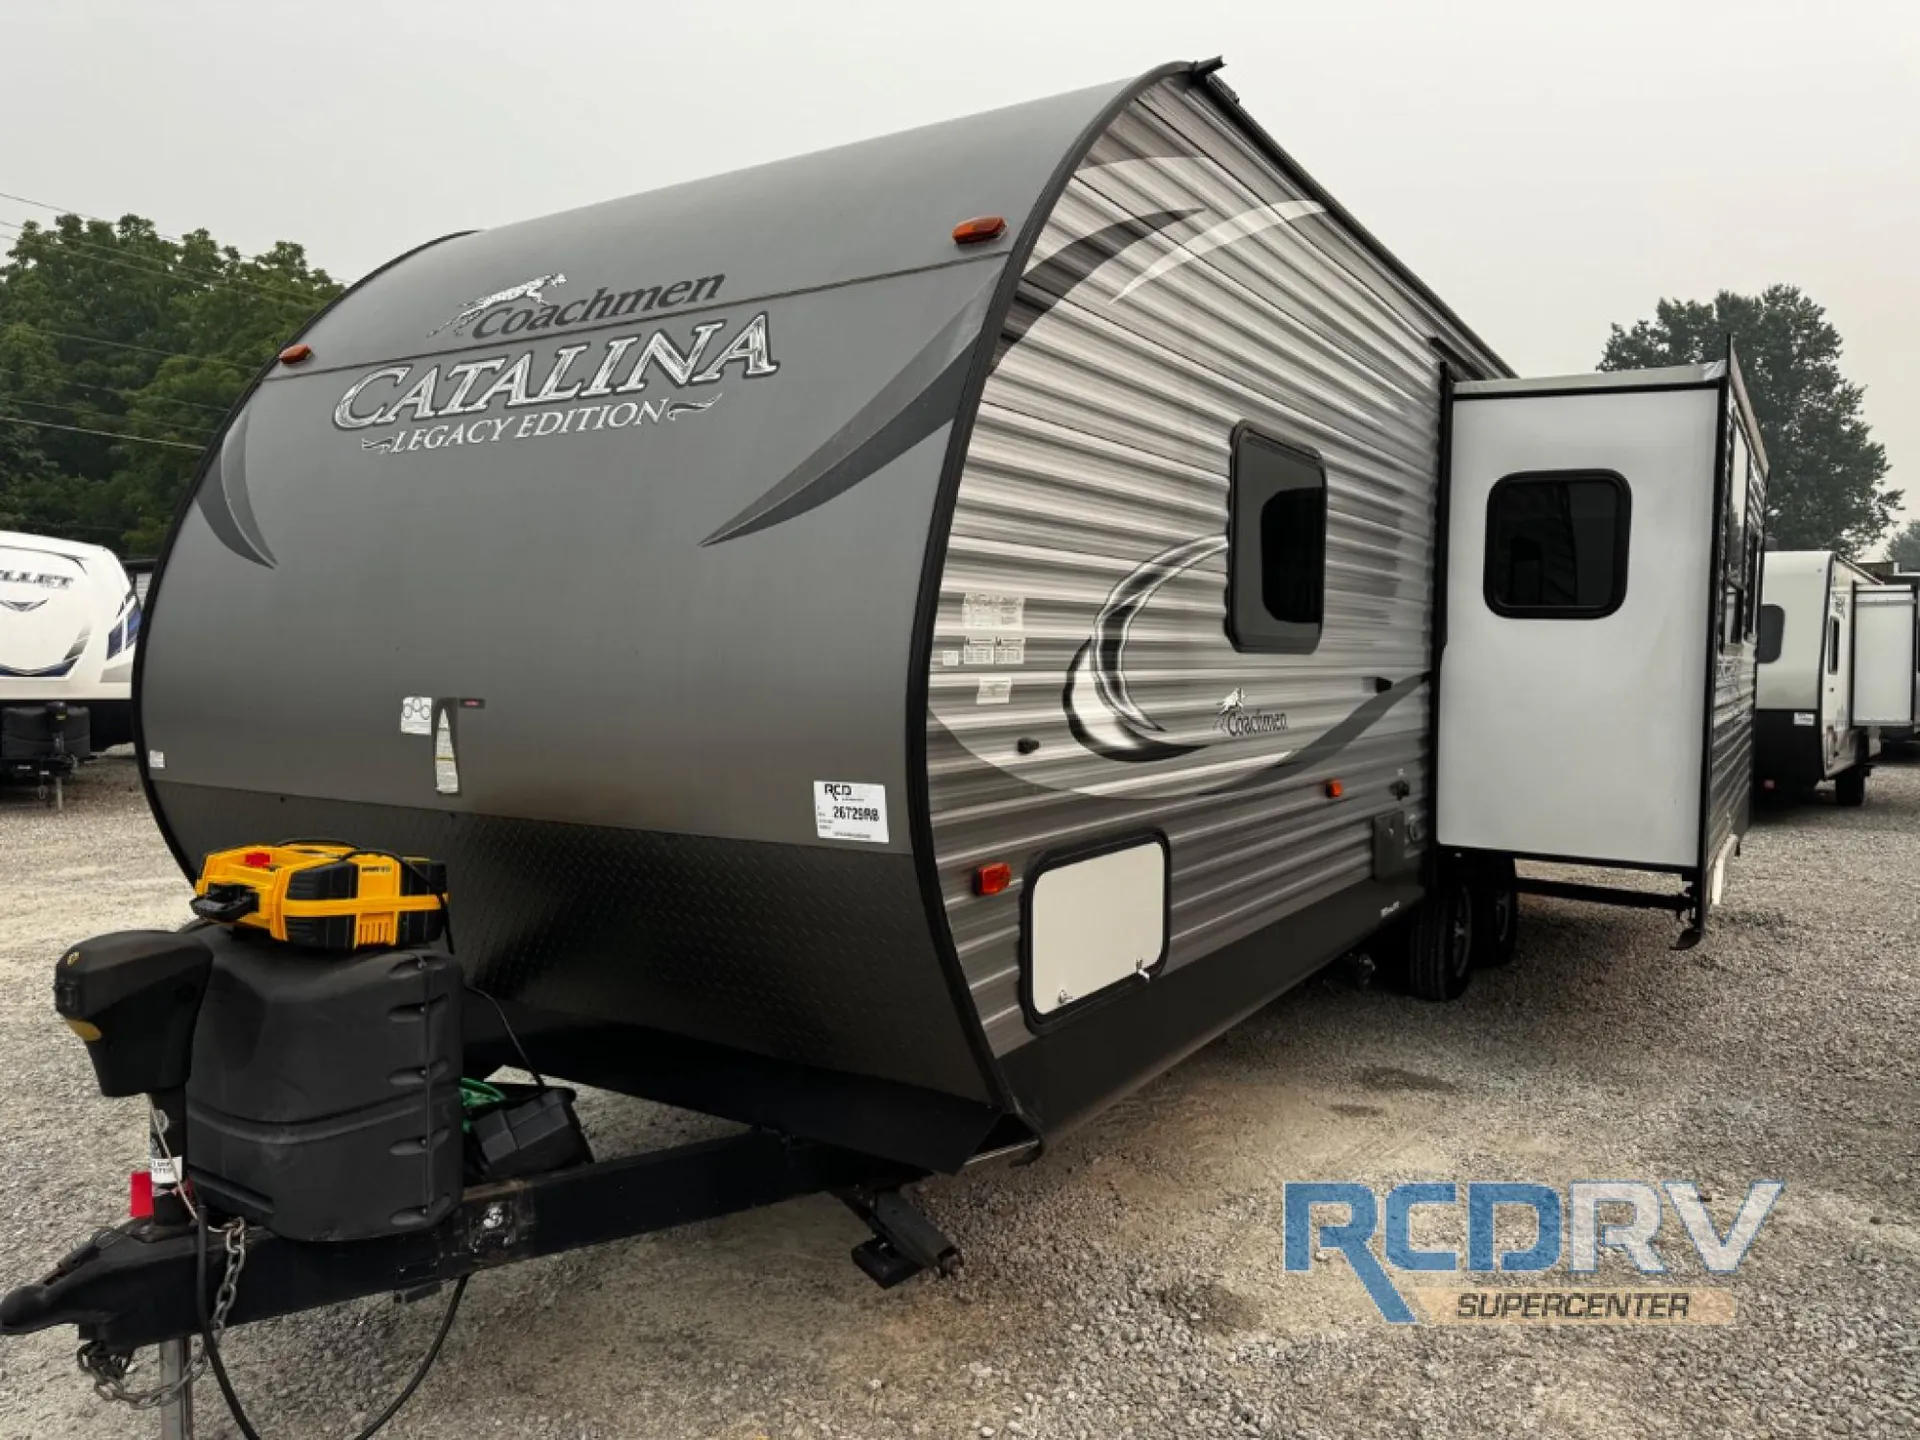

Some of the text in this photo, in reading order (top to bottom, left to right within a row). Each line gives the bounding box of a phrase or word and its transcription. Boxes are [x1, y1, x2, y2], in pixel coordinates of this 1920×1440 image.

[472, 272, 726, 340] Coachmen
[332, 311, 780, 431] CATALINA
[391, 398, 670, 454] LEGACY EDITION
[1226, 708, 1288, 736] Coachmen
